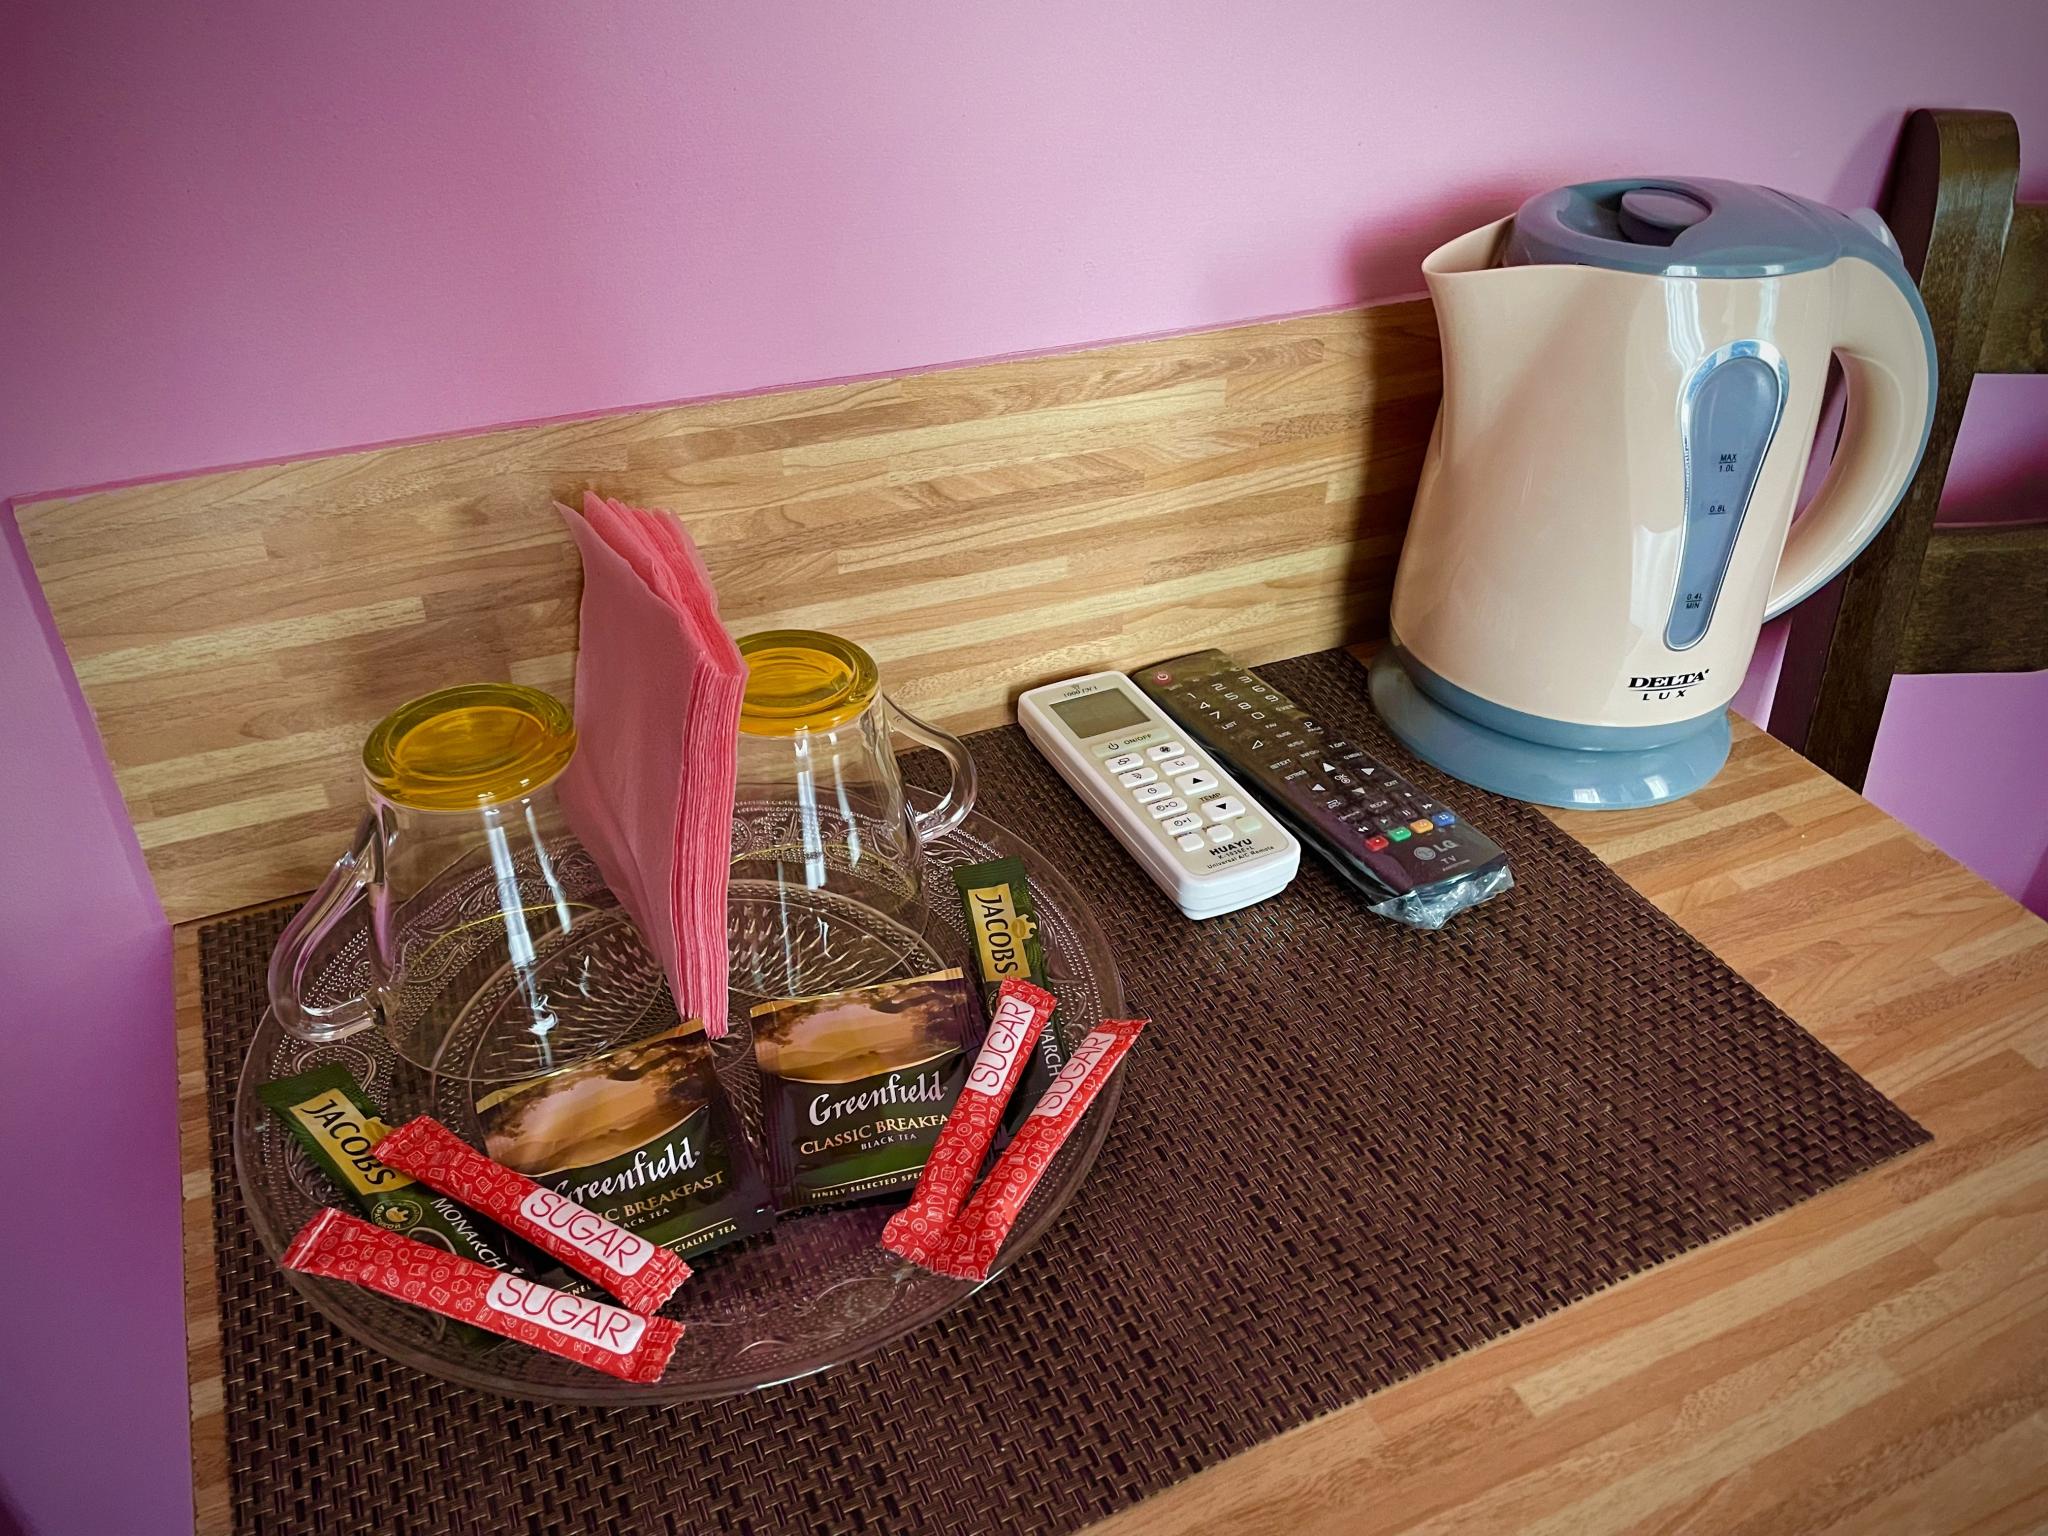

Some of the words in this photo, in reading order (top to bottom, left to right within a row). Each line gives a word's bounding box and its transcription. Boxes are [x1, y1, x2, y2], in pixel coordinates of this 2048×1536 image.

[1720, 453, 1737, 462] MAX
[1628, 671, 1705, 688] DELTA
[1643, 689, 1687, 701] LUX
[1221, 721, 1238, 730] LIST
[1123, 734, 1152, 745] ON/OFF
[1200, 793, 1221, 802] TEMP
[1207, 857, 1238, 869] Universal
[1250, 846, 1275, 856] Remote
[1209, 838, 1253, 856] HUAYU
[1433, 840, 1459, 852] LG
[1440, 855, 1457, 864] TV
[975, 894, 1018, 974] JACOBS
[970, 1001, 1031, 1087] SUGAR
[1041, 1022, 1063, 1077] NARCH
[1036, 1037, 1111, 1110] SUGAR
[809, 1070, 945, 1126] Greenfield
[301, 1099, 396, 1185] JACOBS
[800, 1124, 872, 1155] CLASSIC
[875, 1113, 949, 1135] BREAKFA
[860, 1136, 895, 1150] BLACK
[898, 1132, 917, 1142] TEA
[623, 1170, 725, 1218] BREAKFAST
[812, 1188, 847, 1199] FINELY
[850, 1177, 897, 1193] SELECTED
[530, 1192, 641, 1269] SUGAR
[623, 1216, 645, 1230] ACK
[650, 1208, 670, 1219] TEA
[431, 1197, 507, 1271] MONARCH
[672, 1231, 716, 1253] CIALITY
[718, 1224, 737, 1235] TEA
[497, 1277, 631, 1348] SUGAR
